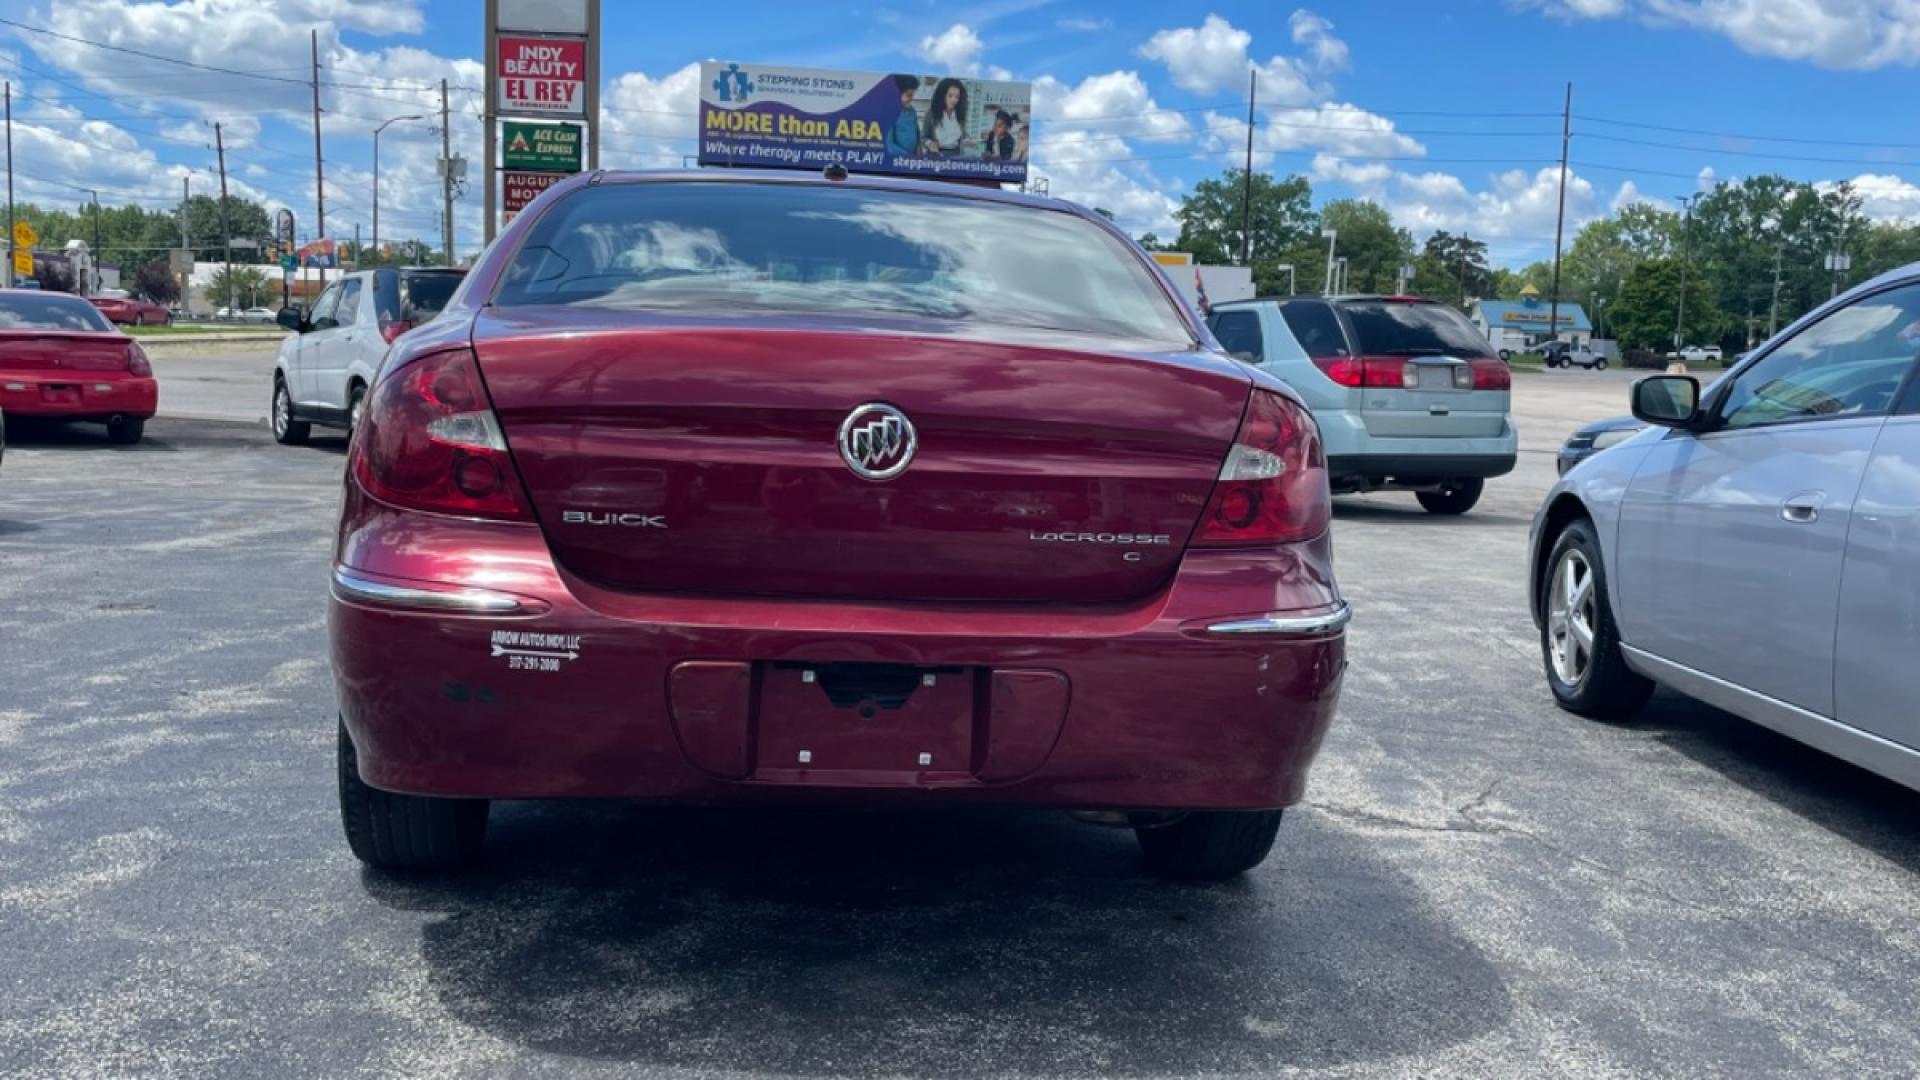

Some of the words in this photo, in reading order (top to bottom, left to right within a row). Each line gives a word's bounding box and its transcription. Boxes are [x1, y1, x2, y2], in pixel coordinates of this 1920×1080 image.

[519, 46, 563, 61] INDY
[505, 59, 577, 77] BEAUTY
[758, 73, 810, 87] STEPPING
[812, 79, 855, 90] STONES
[506, 80, 529, 100] EL
[535, 81, 577, 103] REY
[706, 110, 773, 134] MORE
[778, 113, 830, 137] than
[834, 119, 883, 141] ABA
[532, 129, 553, 142] ACE
[706, 141, 745, 156] Where
[749, 142, 800, 162] therapy
[803, 149, 843, 163] meets
[846, 150, 885, 166] PLAY!
[893, 156, 1025, 176] steppingstonesindy.com
[507, 175, 559, 187] AUGUS
[563, 511, 668, 528] BUICK
[491, 630, 520, 646] ARROW
[520, 631, 545, 648] AUTOS
